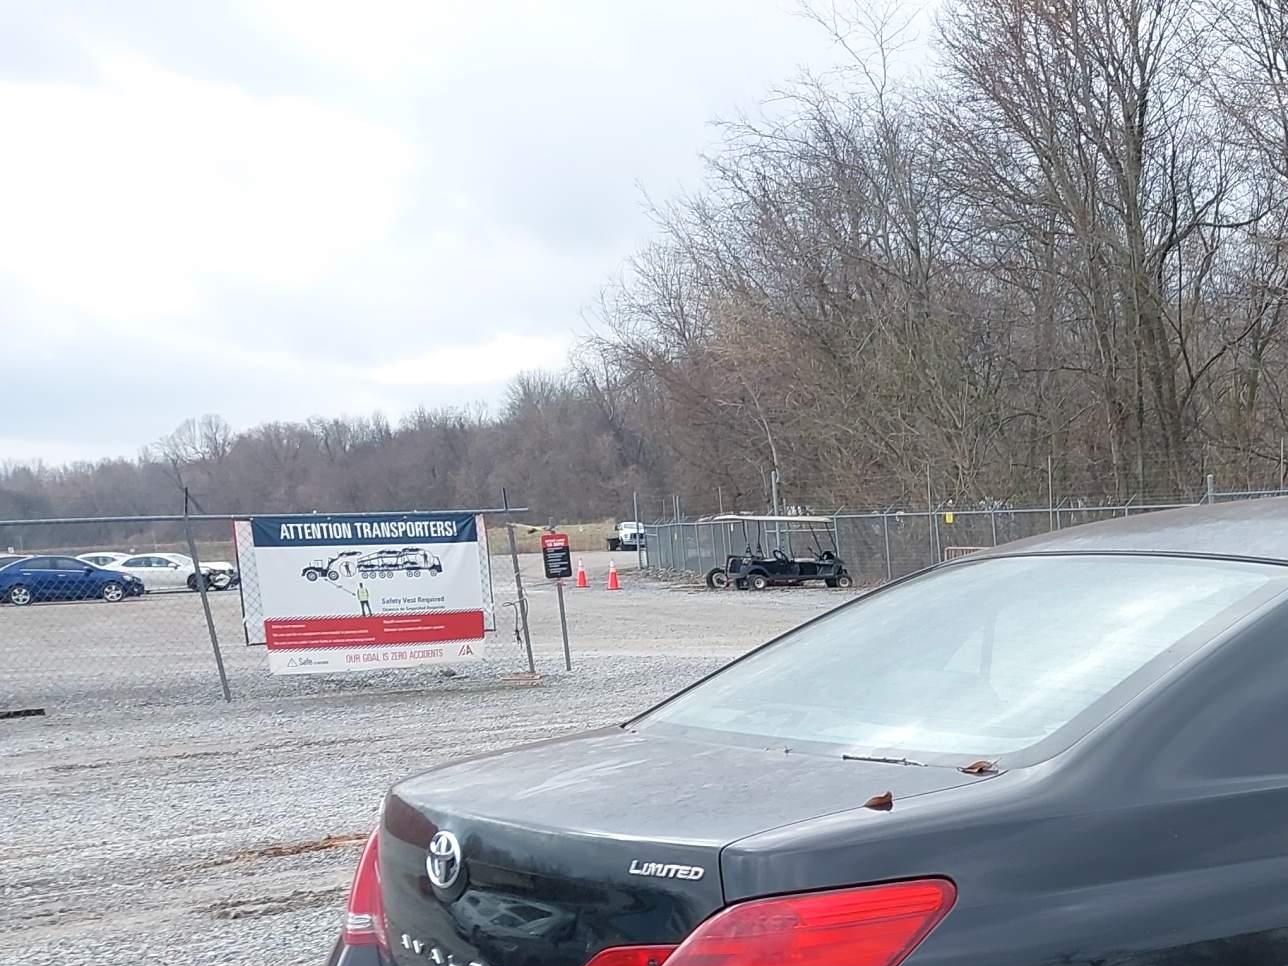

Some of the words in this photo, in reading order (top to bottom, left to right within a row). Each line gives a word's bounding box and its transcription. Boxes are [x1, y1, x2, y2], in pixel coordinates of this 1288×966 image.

[280, 522, 352, 540] ATTENTION
[354, 520, 458, 538] TRANSPORTERS!
[418, 596, 444, 604] Required
[346, 654, 360, 663] OUR
[362, 654, 380, 662] GOAL
[382, 653, 389, 662] IS
[390, 652, 407, 660] ZERO
[410, 649, 444, 660] ACCIDENTS
[628, 859, 705, 882] LIMITED
